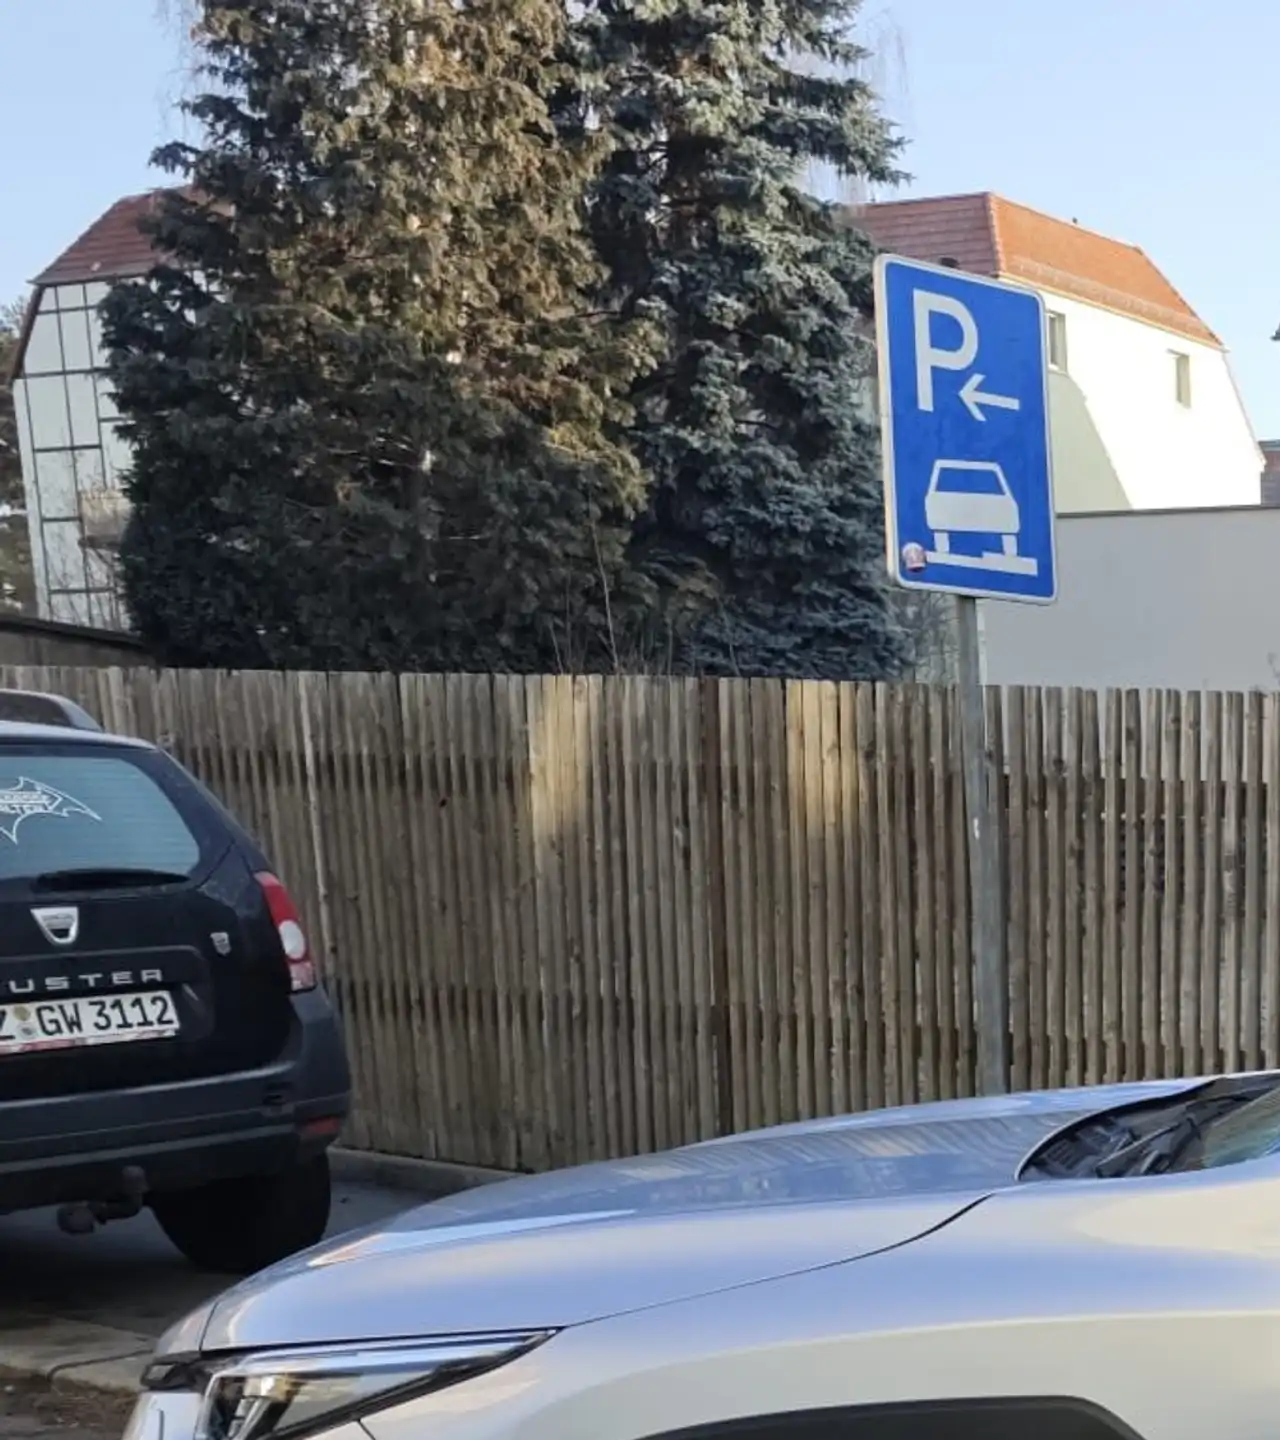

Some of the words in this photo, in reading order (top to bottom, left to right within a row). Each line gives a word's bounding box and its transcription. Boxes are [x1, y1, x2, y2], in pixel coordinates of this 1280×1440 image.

[913, 288, 978, 412] P
[35, 1002, 83, 1037] GW
[88, 995, 174, 1031] 3112
